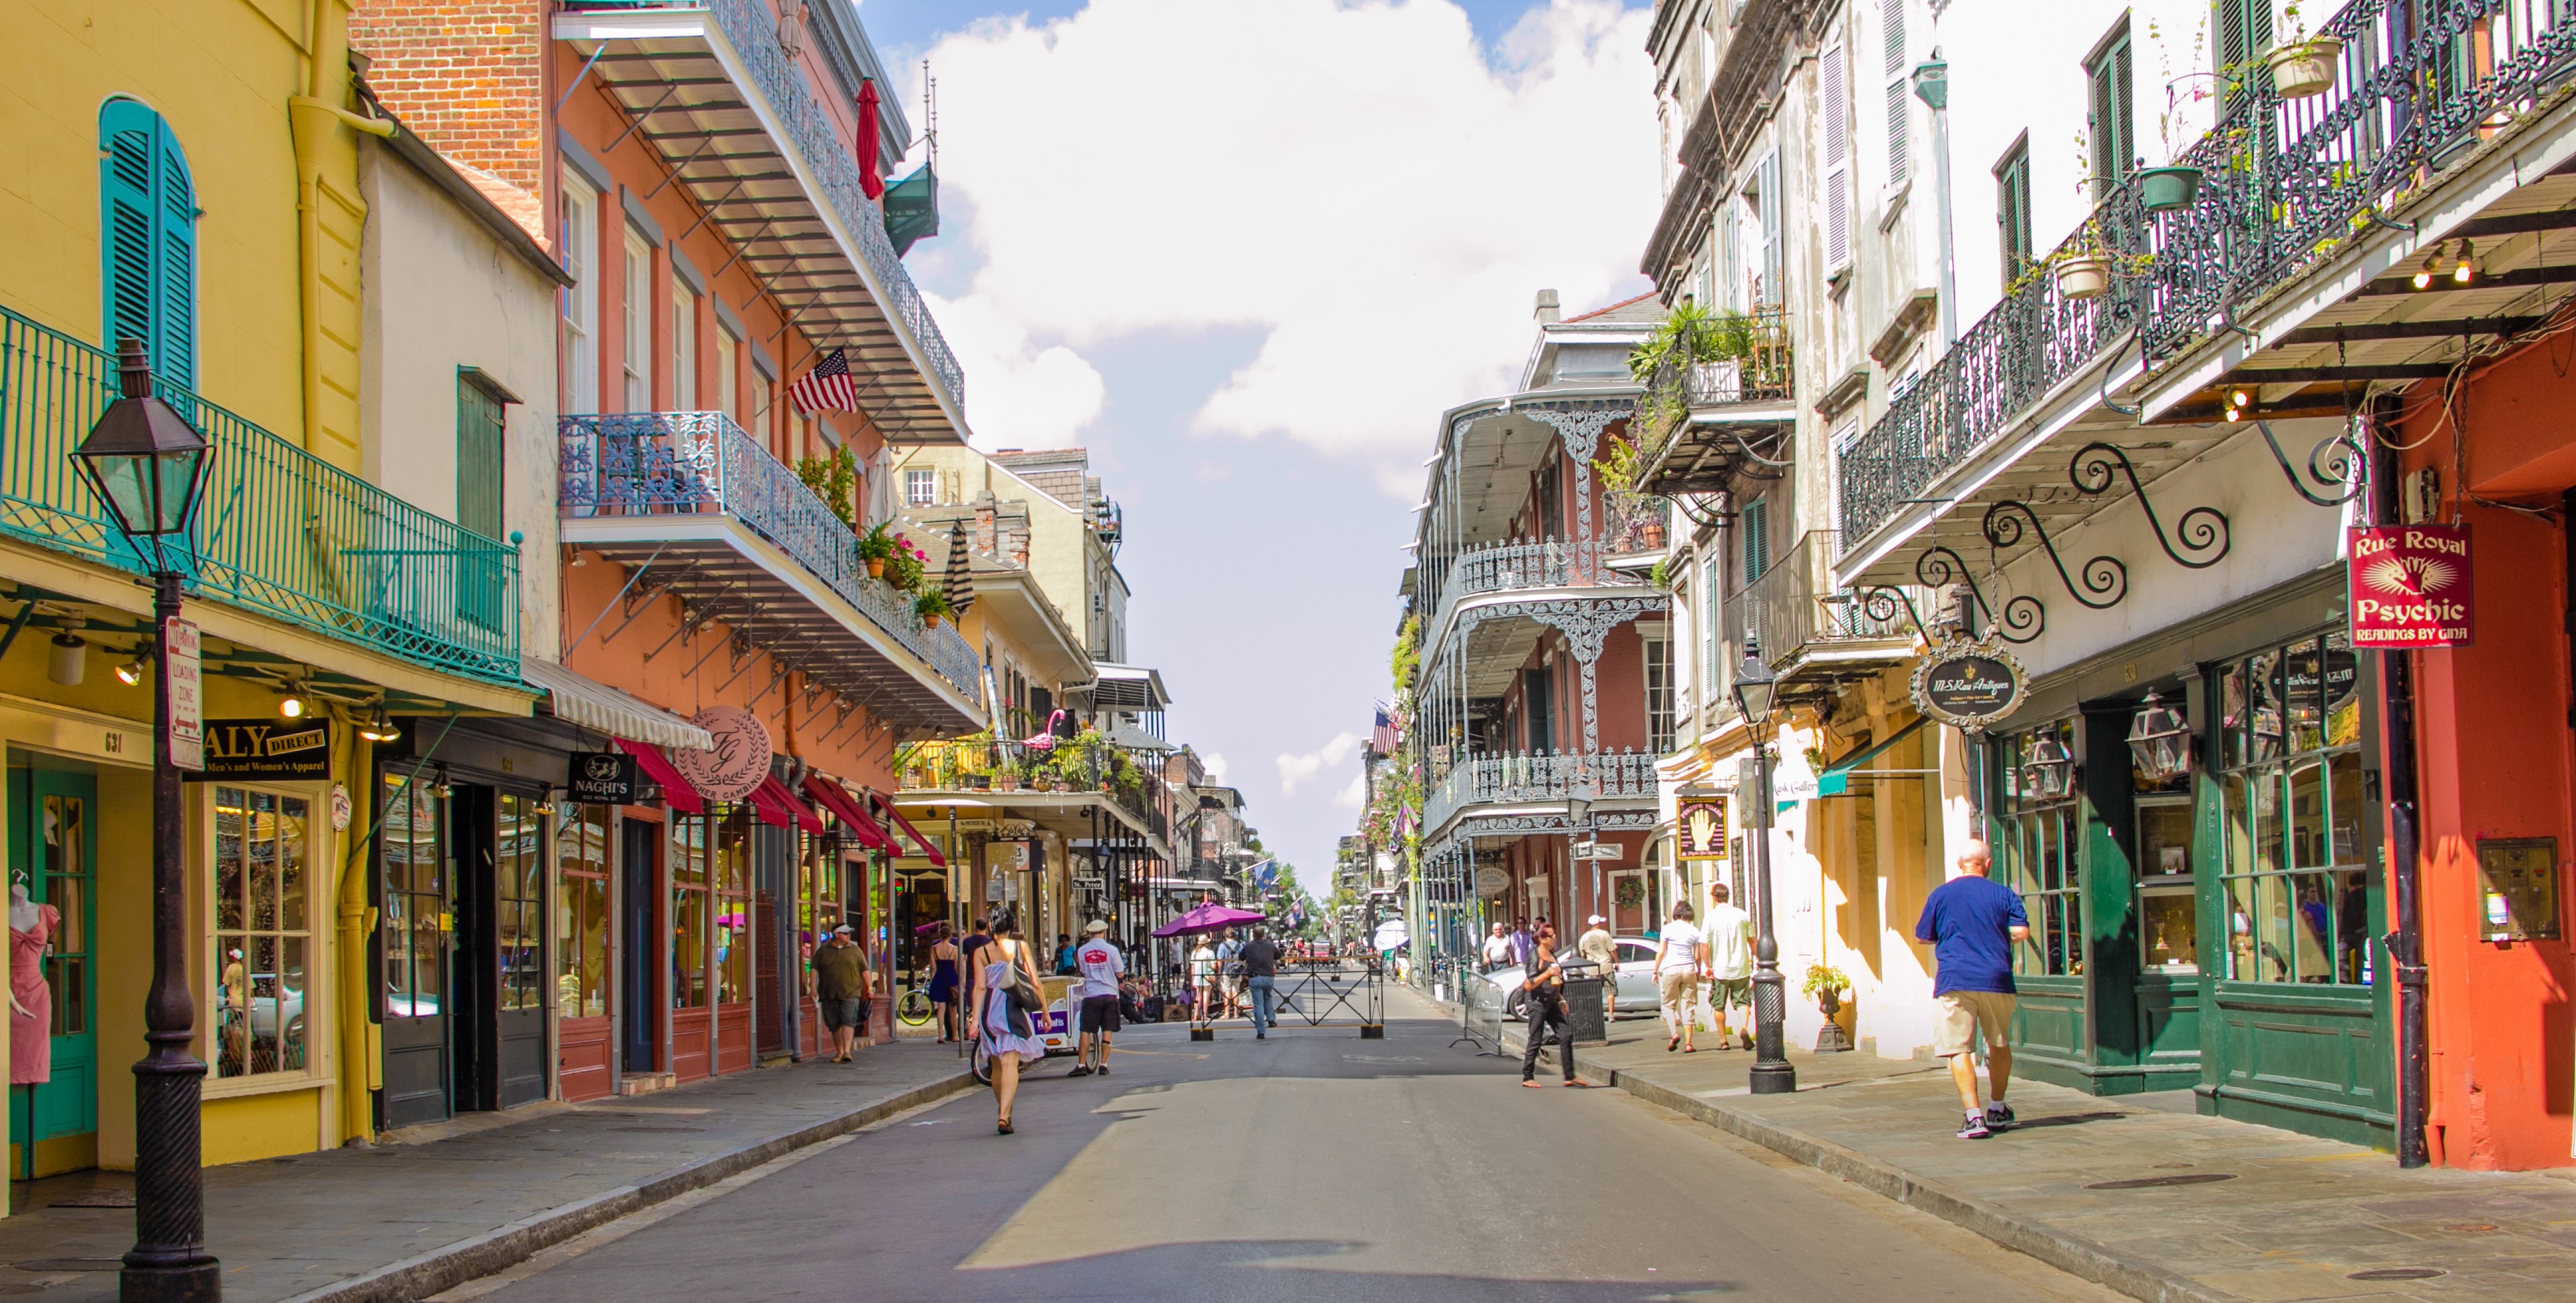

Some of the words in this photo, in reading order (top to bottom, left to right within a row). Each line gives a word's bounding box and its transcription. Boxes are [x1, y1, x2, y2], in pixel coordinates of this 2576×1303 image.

[2356, 537, 2397, 558] Rue
[2405, 531, 2466, 556] Royal
[2357, 598, 2465, 625] Psychic
[168, 625, 180, 649] NO
[2357, 629, 2416, 641] READINGS
[2418, 628, 2436, 640] BY
[2438, 628, 2467, 639] GINA
[173, 662, 197, 683] LOADING
[179, 686, 193, 703] ZONE
[1972, 678, 2009, 696] Antiques
[106, 731, 122, 753] 631
[272, 733, 321, 752] DIRECT
[207, 763, 232, 772] Men's
[252, 762, 290, 771] Women's
[291, 761, 325, 773] Apparel
[576, 780, 627, 794] NAGHI'S
[683, 772, 716, 799] FISCHER
